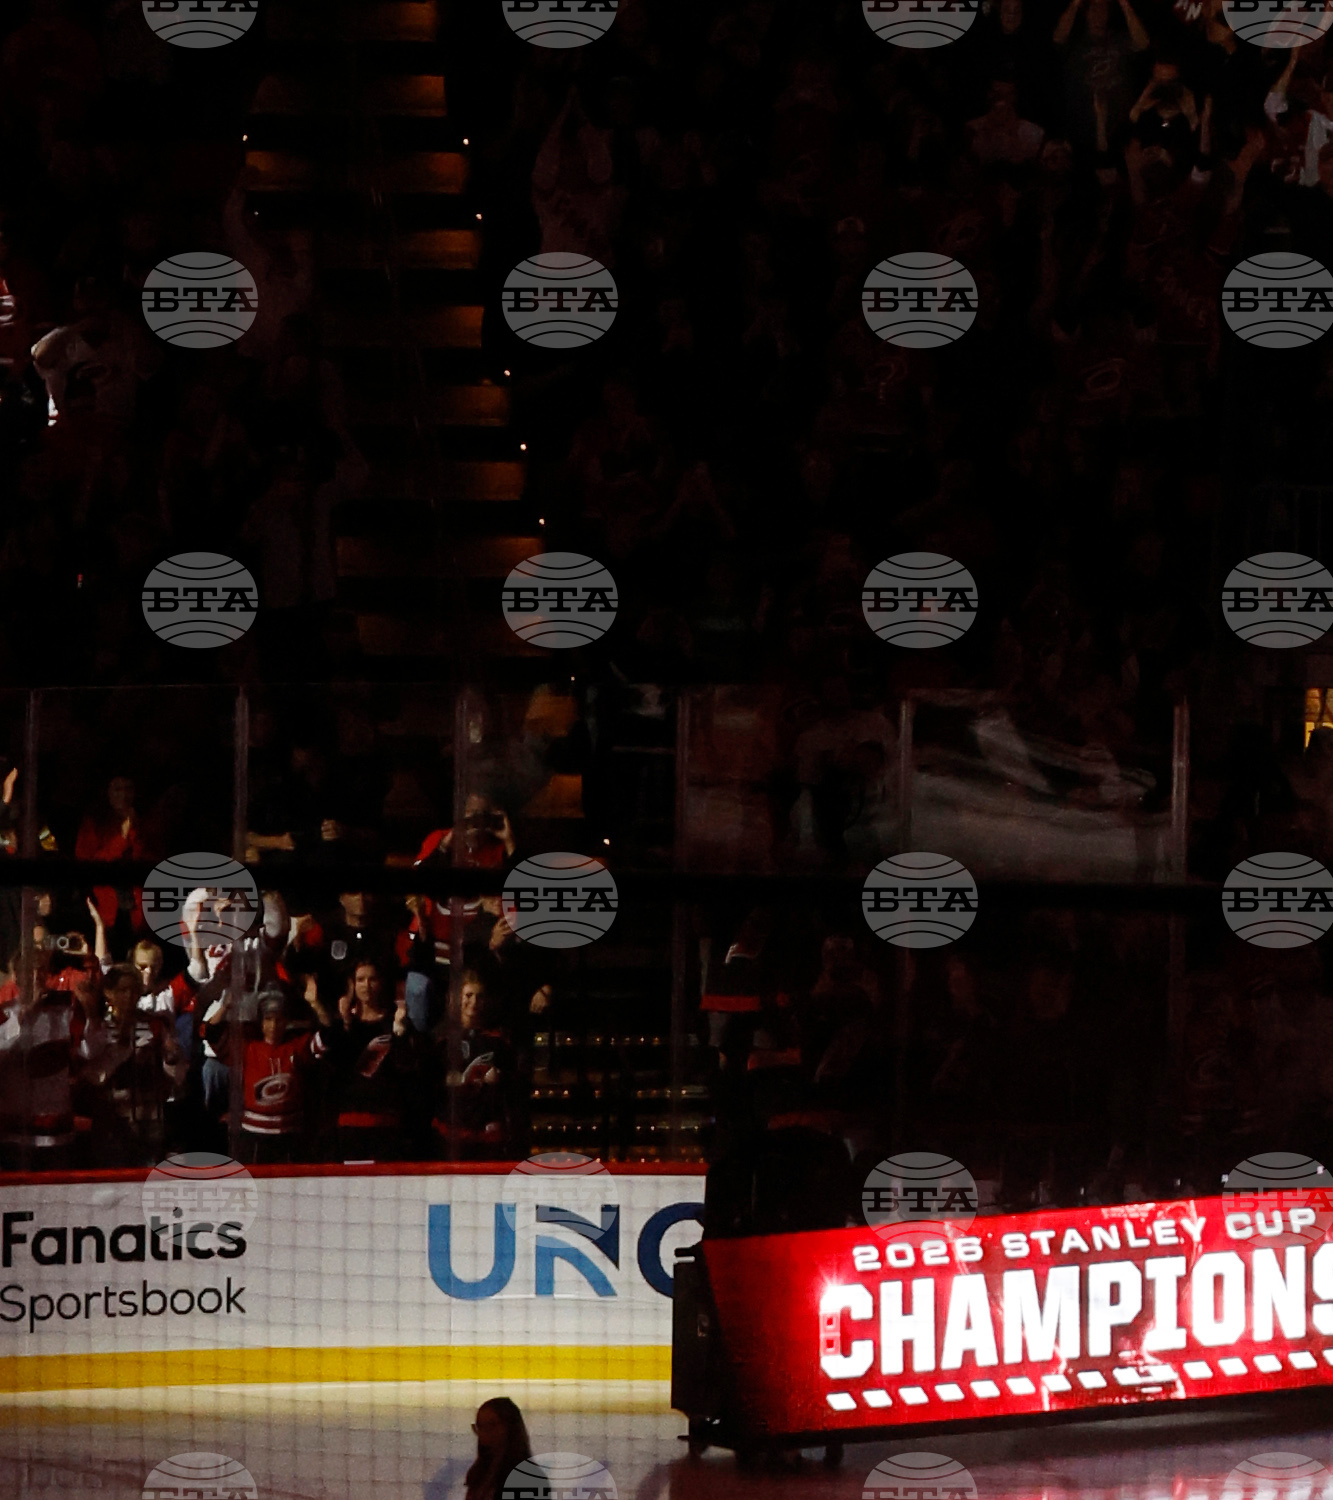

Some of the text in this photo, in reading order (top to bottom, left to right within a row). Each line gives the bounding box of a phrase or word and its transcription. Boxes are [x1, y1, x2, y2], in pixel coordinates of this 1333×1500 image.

[2, 1207, 248, 1269] Fanatics
[853, 1206, 1318, 1272] 2026 STANLEY CUP
[0, 1277, 247, 1334] Sportsbook
